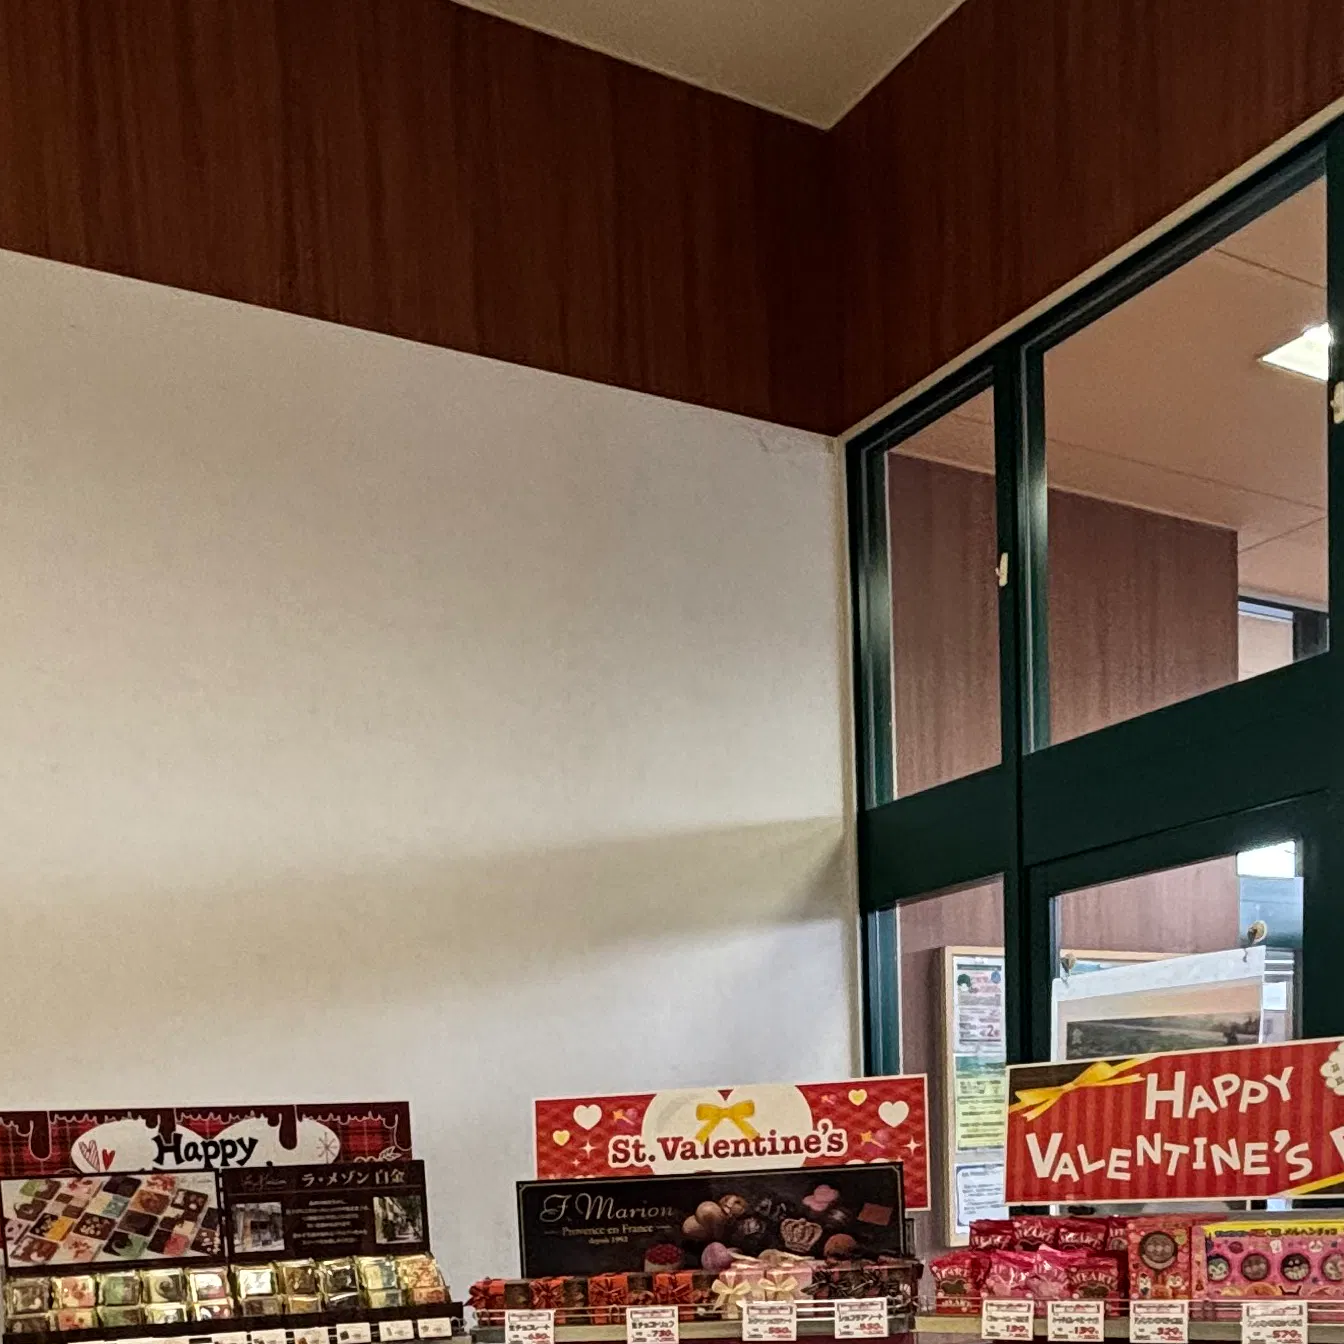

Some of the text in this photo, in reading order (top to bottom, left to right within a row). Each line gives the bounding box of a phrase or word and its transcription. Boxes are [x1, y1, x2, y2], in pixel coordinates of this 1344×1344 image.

[1144, 1066, 1295, 1121] HAPPY
[152, 1131, 259, 1167] Happy
[1025, 1129, 1313, 1183] VALENTINE'S
[574, 1192, 674, 1221] Marion
